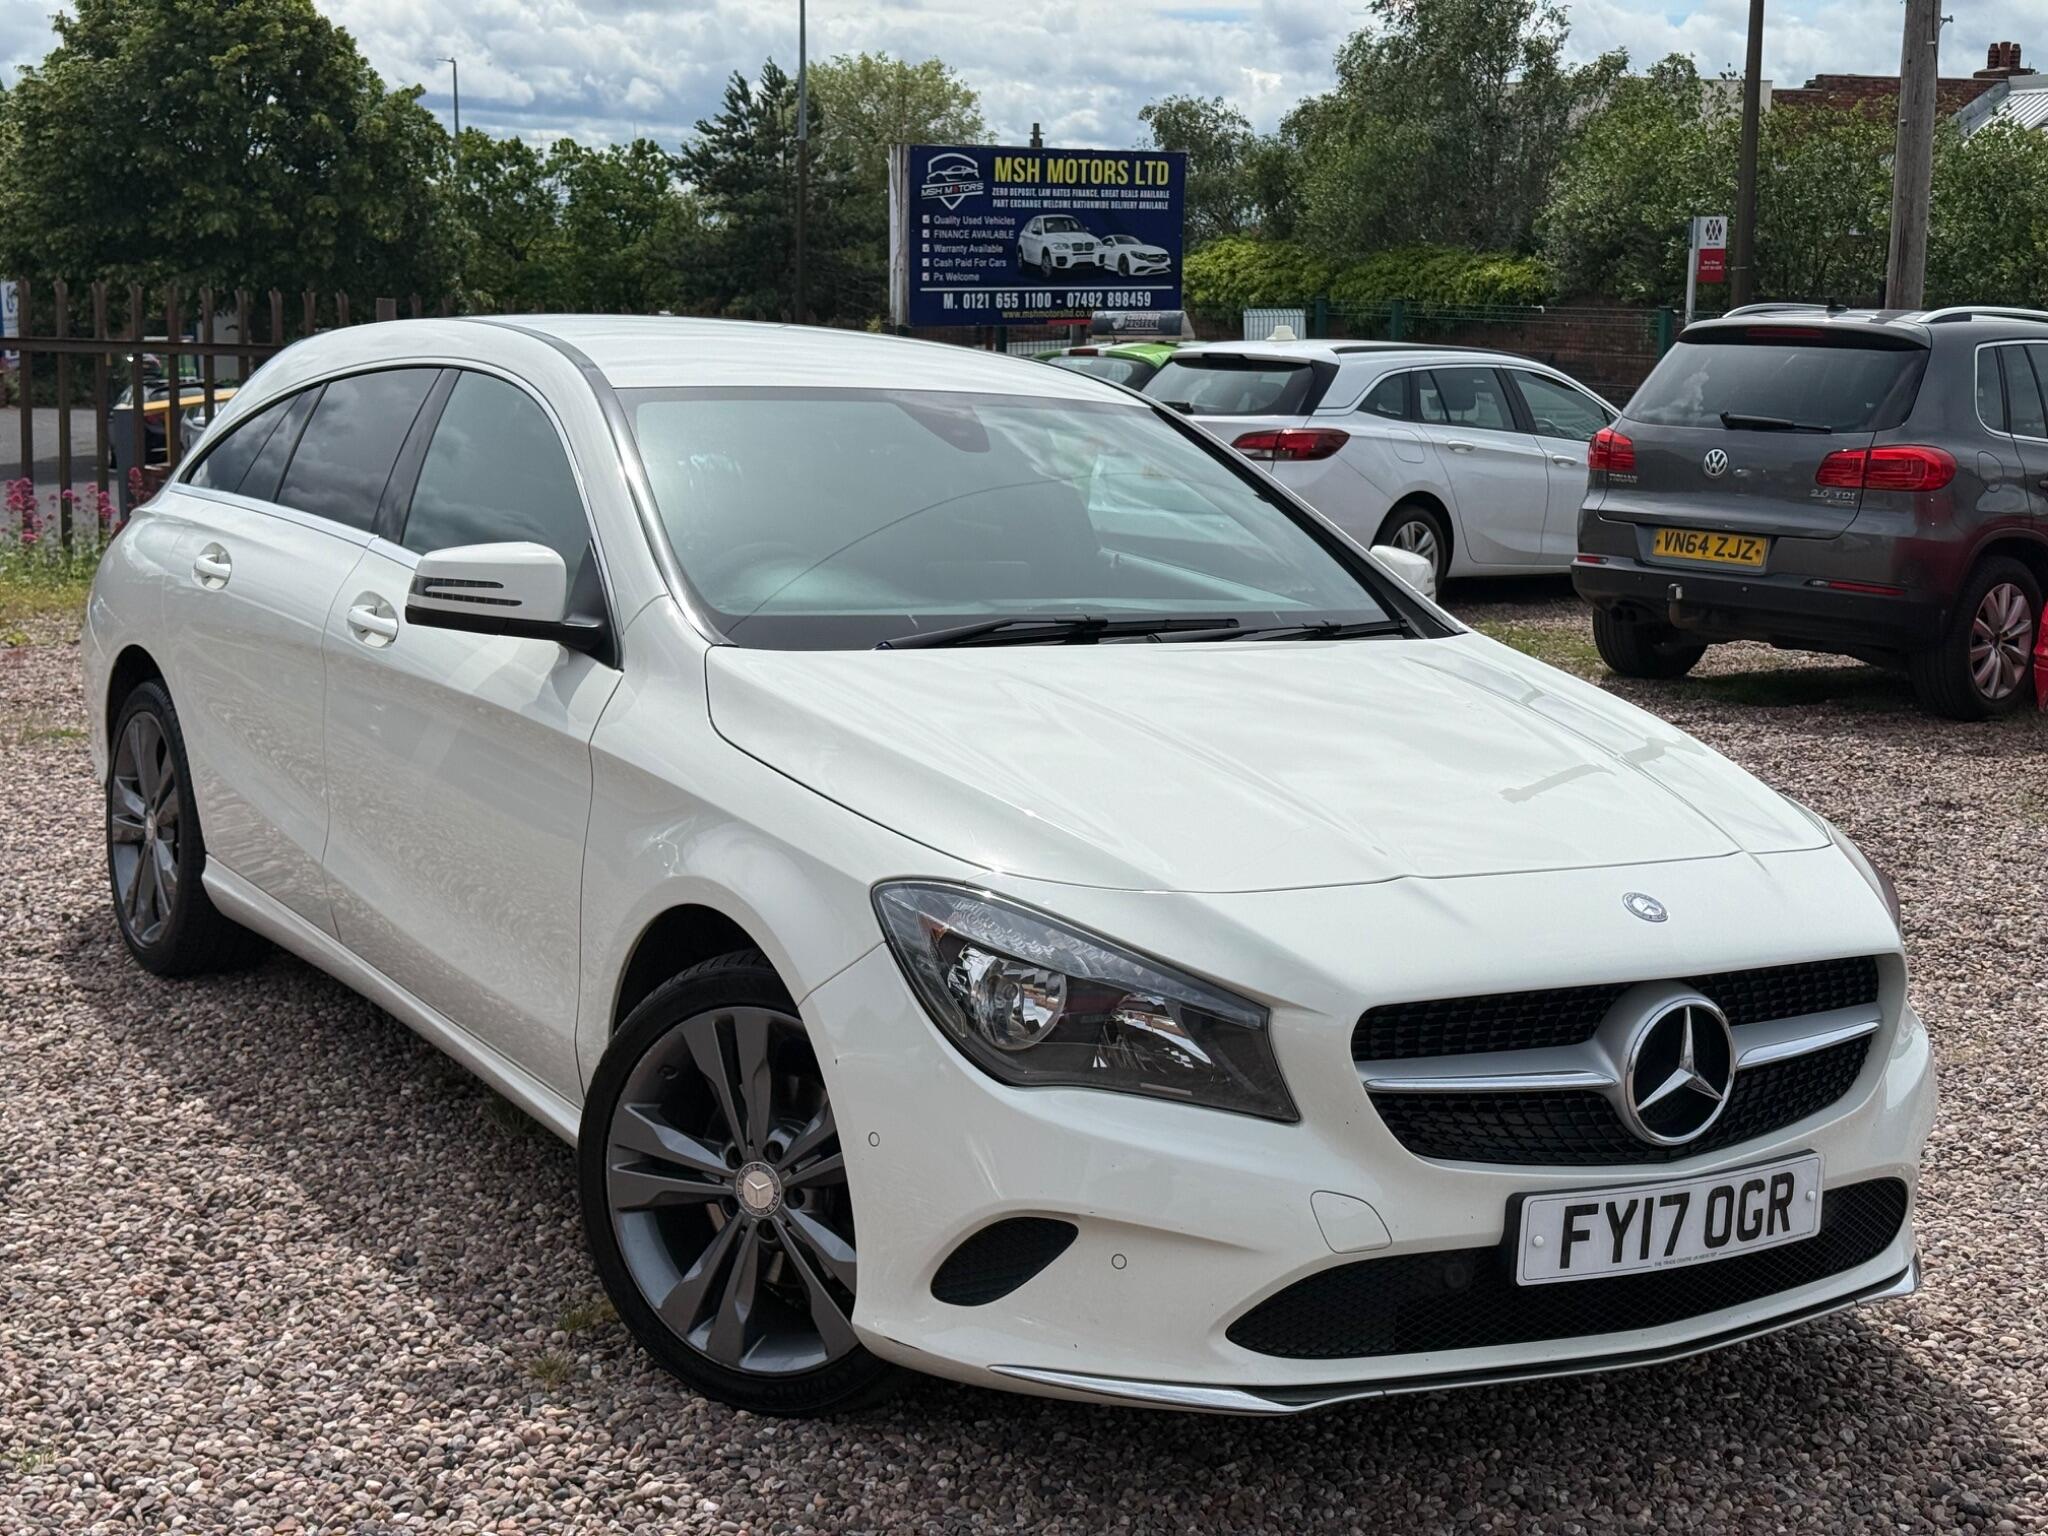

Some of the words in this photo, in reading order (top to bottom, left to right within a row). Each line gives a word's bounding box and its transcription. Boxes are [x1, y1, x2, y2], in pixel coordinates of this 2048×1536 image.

[994, 157, 1040, 183] MSH
[1047, 158, 1129, 185] MOTORS
[1135, 160, 1170, 186] LTD
[921, 187, 943, 197] MSH
[992, 187, 1009, 197] ZERO
[1052, 188, 1071, 198] RATES
[1101, 189, 1119, 198] GREAT
[1120, 190, 1138, 198] DEALS
[1140, 190, 1170, 199] AVAILABLE
[993, 199, 1009, 208] PART
[1010, 199, 1041, 209] EXCHANGE
[1043, 200, 1072, 209] WELCOME
[1072, 200, 1109, 209] NATIONWIDE
[1111, 200, 1137, 209] DELIVERY
[1138, 201, 1169, 210] AVAILABLE
[933, 215, 960, 227] Quality
[962, 216, 982, 225] Used
[984, 216, 1015, 225] Vehicles
[934, 229, 969, 239] FINANCE
[971, 230, 1015, 239] AVAILABLE
[933, 244, 967, 255] Warranty
[968, 244, 1004, 253] Available
[933, 258, 953, 267] Cash
[955, 258, 973, 267] Paid
[974, 258, 987, 267] For
[988, 258, 1007, 267] Cars
[933, 272, 944, 281] Px
[945, 272, 980, 281] Welcome
[943, 293, 958, 309] M.
[963, 293, 990, 309] 0121
[996, 293, 1019, 309] 655
[1025, 292, 1052, 308] 1100
[1066, 292, 1103, 308] 07492
[1107, 291, 1152, 307] 898459
[1664, 531, 1709, 555] VN64
[1714, 536, 1756, 560] ZJZ
[1559, 1192, 1690, 1269] FY17
[1703, 1171, 1795, 1249] OGR
